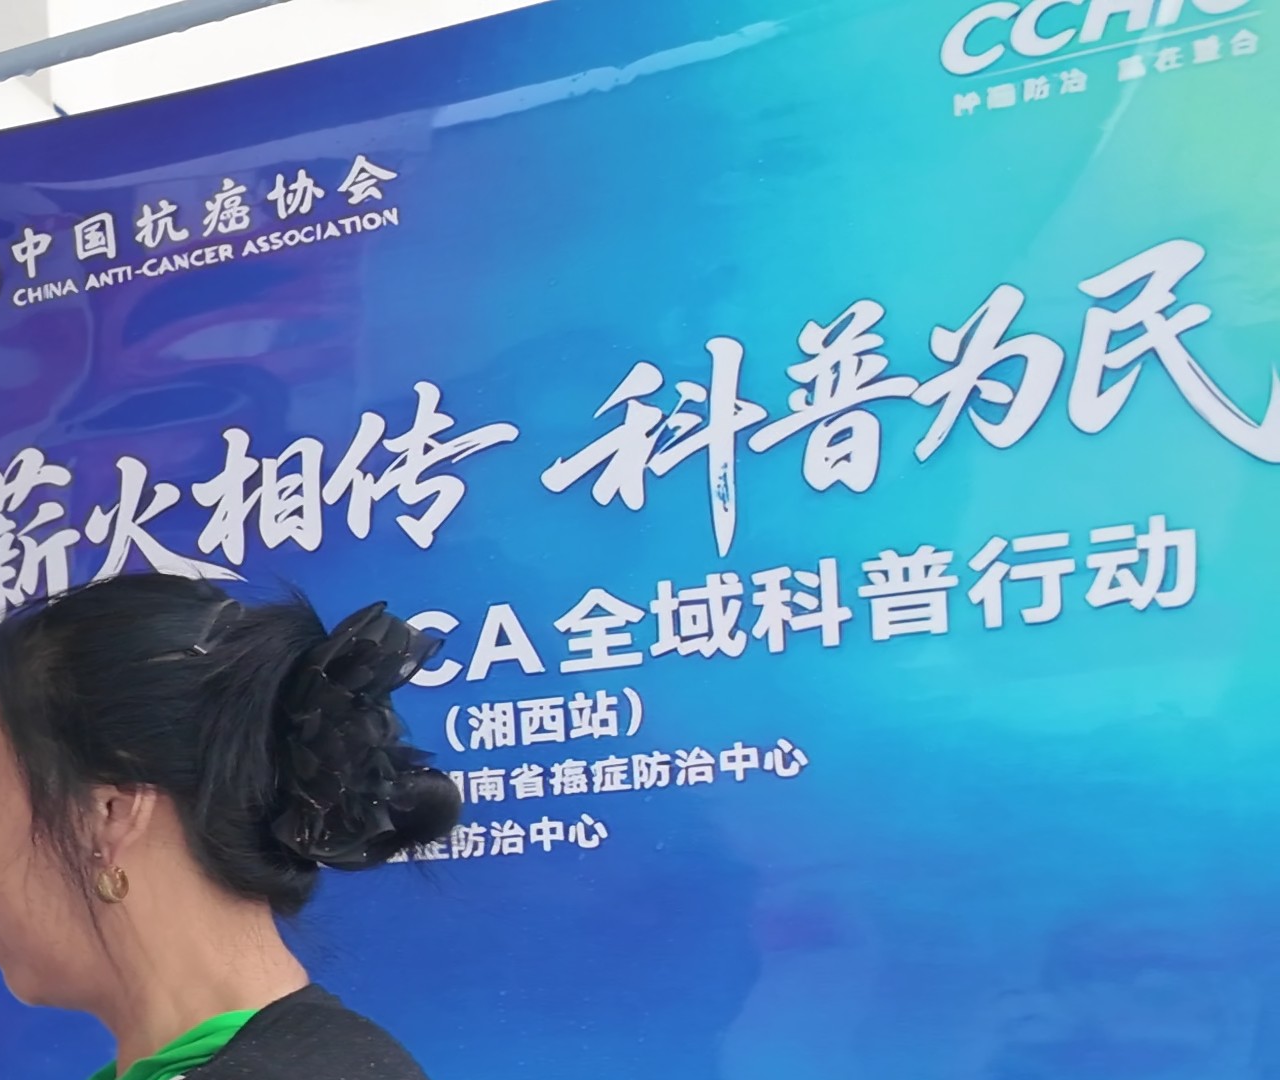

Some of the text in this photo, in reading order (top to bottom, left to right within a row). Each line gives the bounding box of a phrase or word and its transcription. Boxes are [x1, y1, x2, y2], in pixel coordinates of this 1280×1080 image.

[941, 0, 1255, 76] CCH
[12, 154, 398, 279] 中国抗癌协会
[13, 278, 79, 307] CHINA
[85, 244, 234, 291] ANTI-CANCER
[242, 207, 399, 257] ASSOCIATION
[542, 239, 1280, 557] 科普为民
[387, 813, 608, 863] 防治中心
